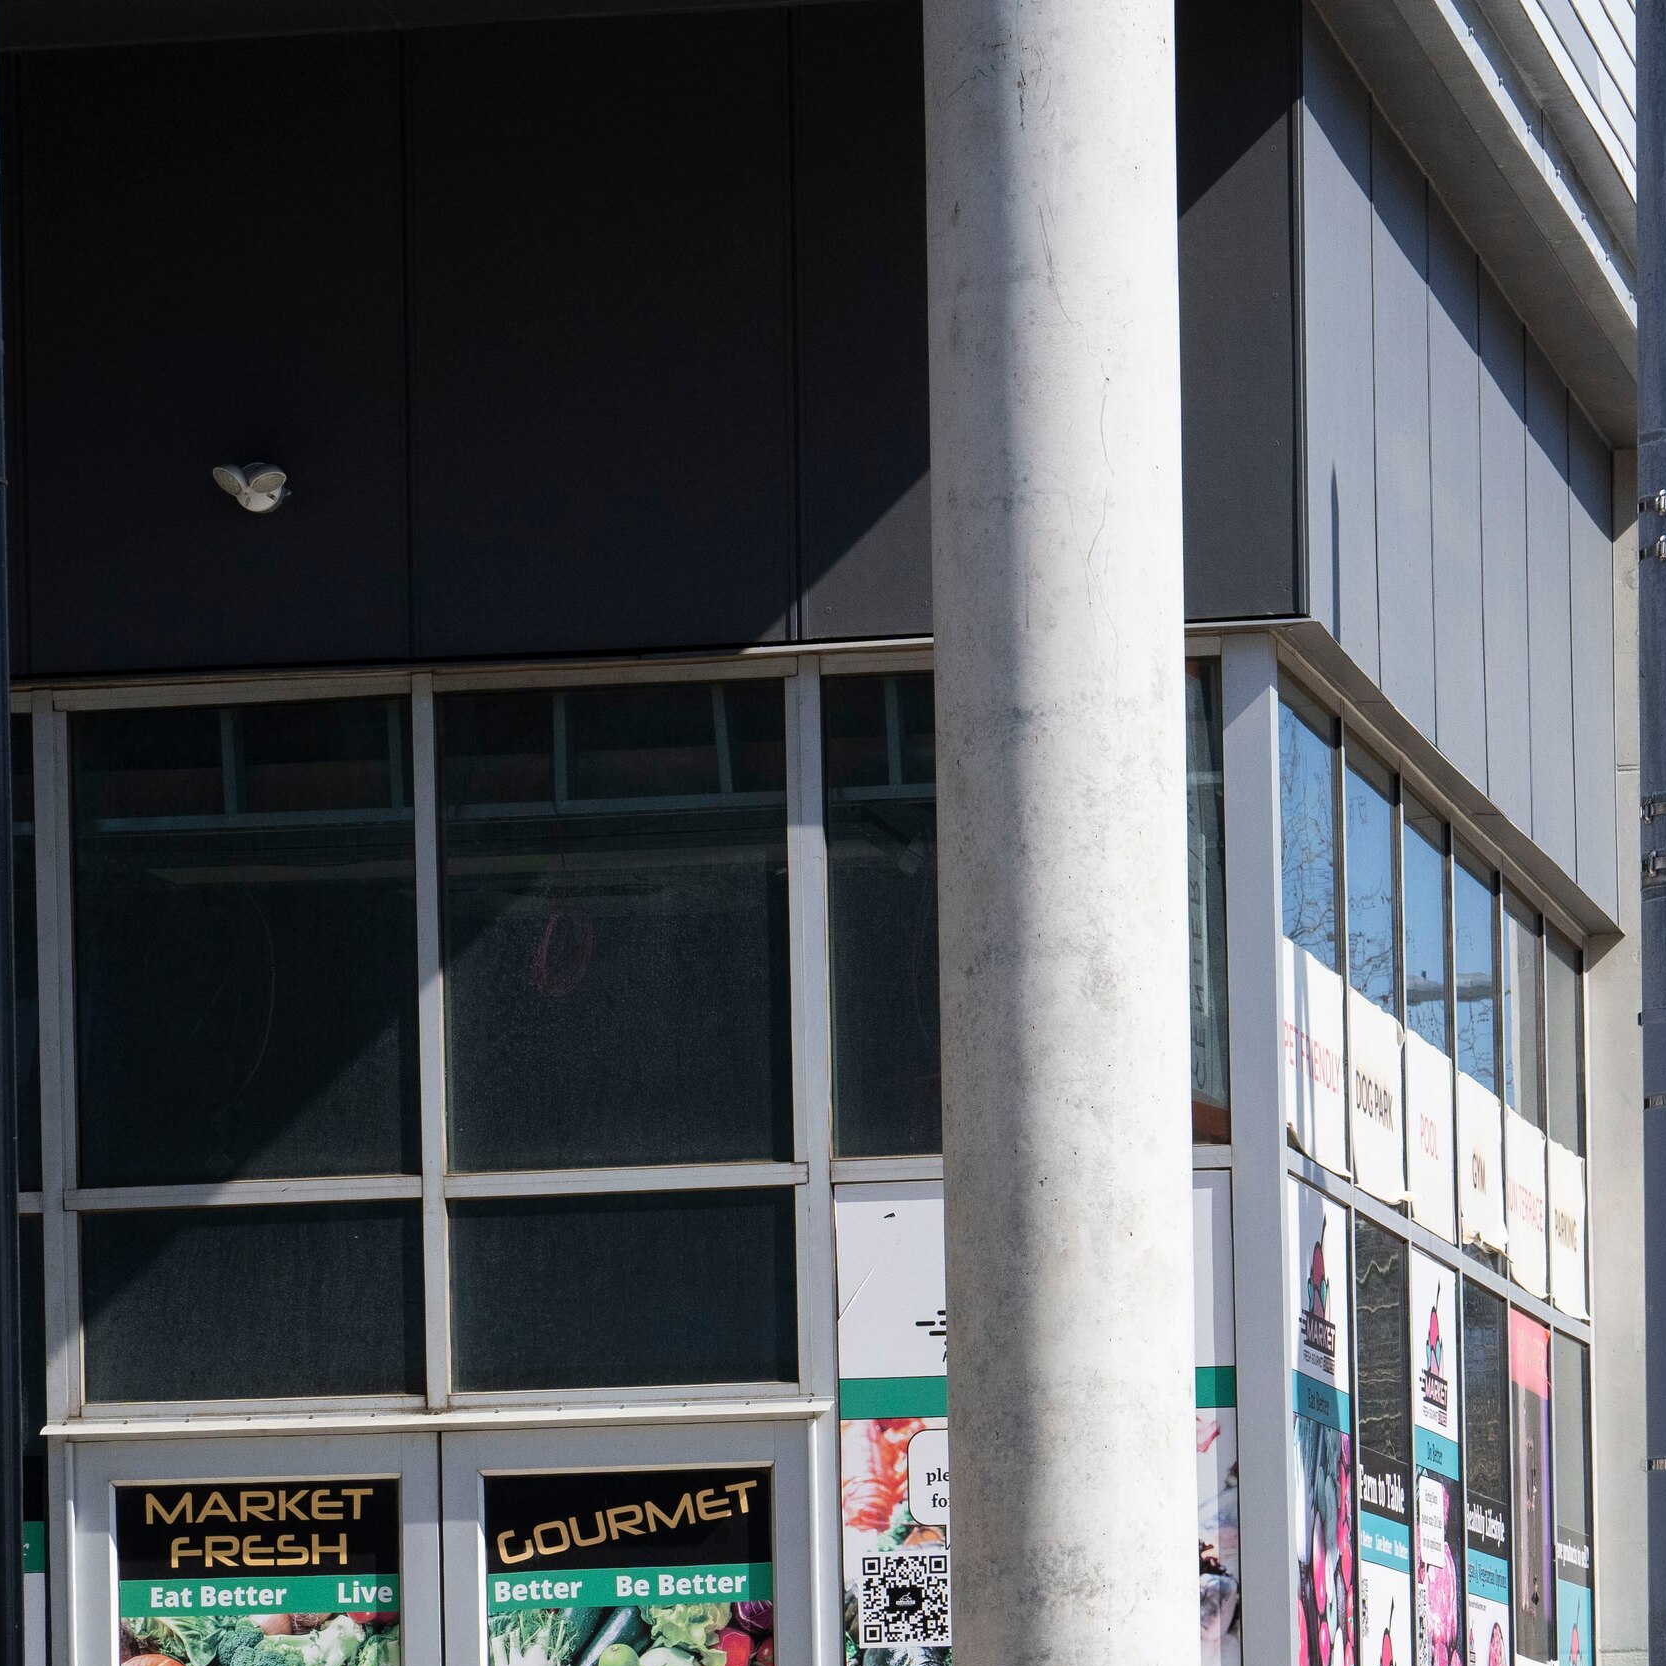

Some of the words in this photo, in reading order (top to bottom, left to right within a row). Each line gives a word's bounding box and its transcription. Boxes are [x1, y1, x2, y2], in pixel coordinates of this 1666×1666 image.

[1300, 1031, 1341, 1096] FRIENDLY
[1356, 1069, 1374, 1118] DOG
[1375, 1083, 1394, 1133] PARK
[1420, 1113, 1439, 1161] POOL
[1471, 1152, 1487, 1196] GYM
[1554, 1207, 1578, 1254] PARKING
[1306, 1316, 1336, 1352] MARKET
[1424, 1378, 1448, 1406] MARKET
[146, 1488, 374, 1525] MARKET
[1359, 1463, 1378, 1505] Farm
[1378, 1473, 1386, 1508] to
[1385, 1473, 1405, 1515] Table
[497, 1480, 757, 1564] GOURMET
[171, 1533, 348, 1568] FRESH
[150, 1587, 192, 1608] Eat
[200, 1585, 287, 1607] Better
[338, 1581, 393, 1604] Live
[494, 1580, 582, 1602] Better
[616, 1575, 650, 1597] Be
[658, 1573, 747, 1596] Better
